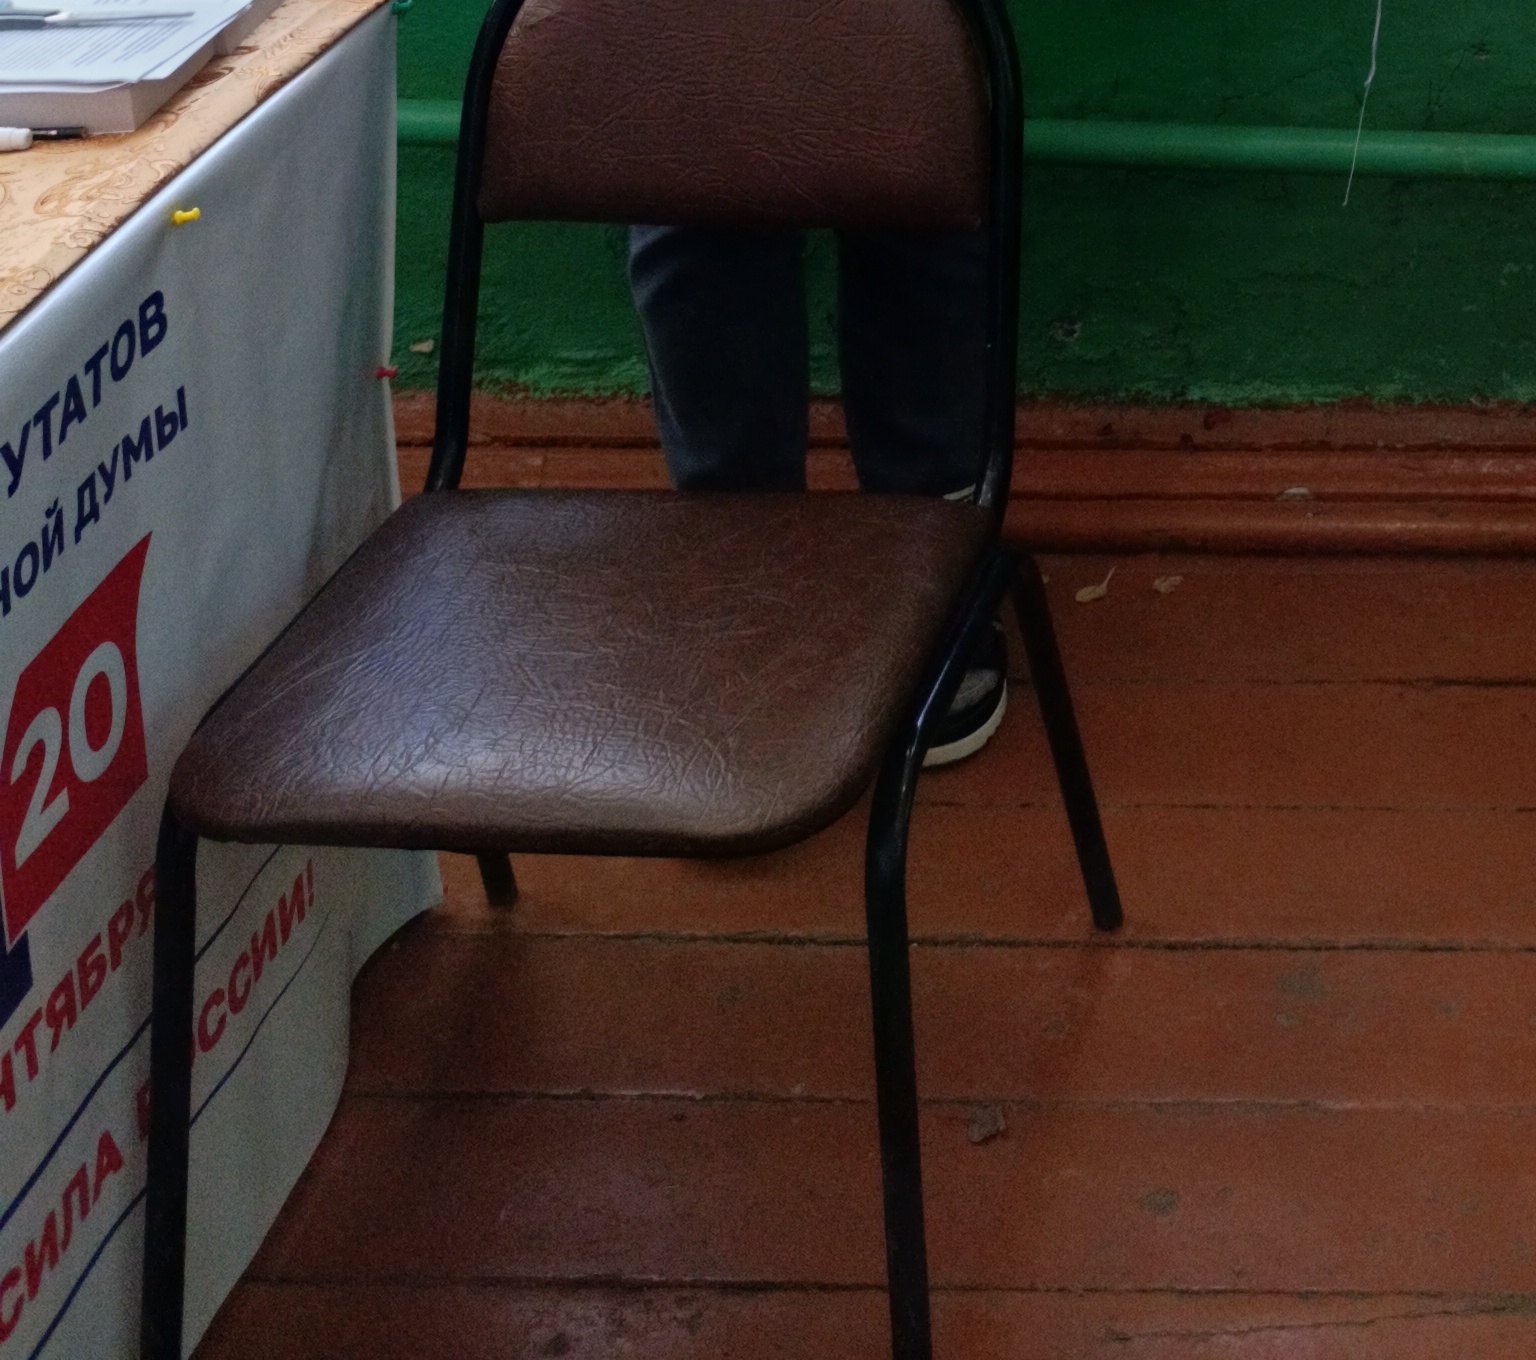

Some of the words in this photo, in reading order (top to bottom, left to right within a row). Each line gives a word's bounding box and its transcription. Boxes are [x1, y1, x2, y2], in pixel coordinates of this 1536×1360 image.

[74, 385, 189, 546] ДУМЫ
[10, 640, 128, 871] 20
[0, 1130, 124, 1344] СИЛА
